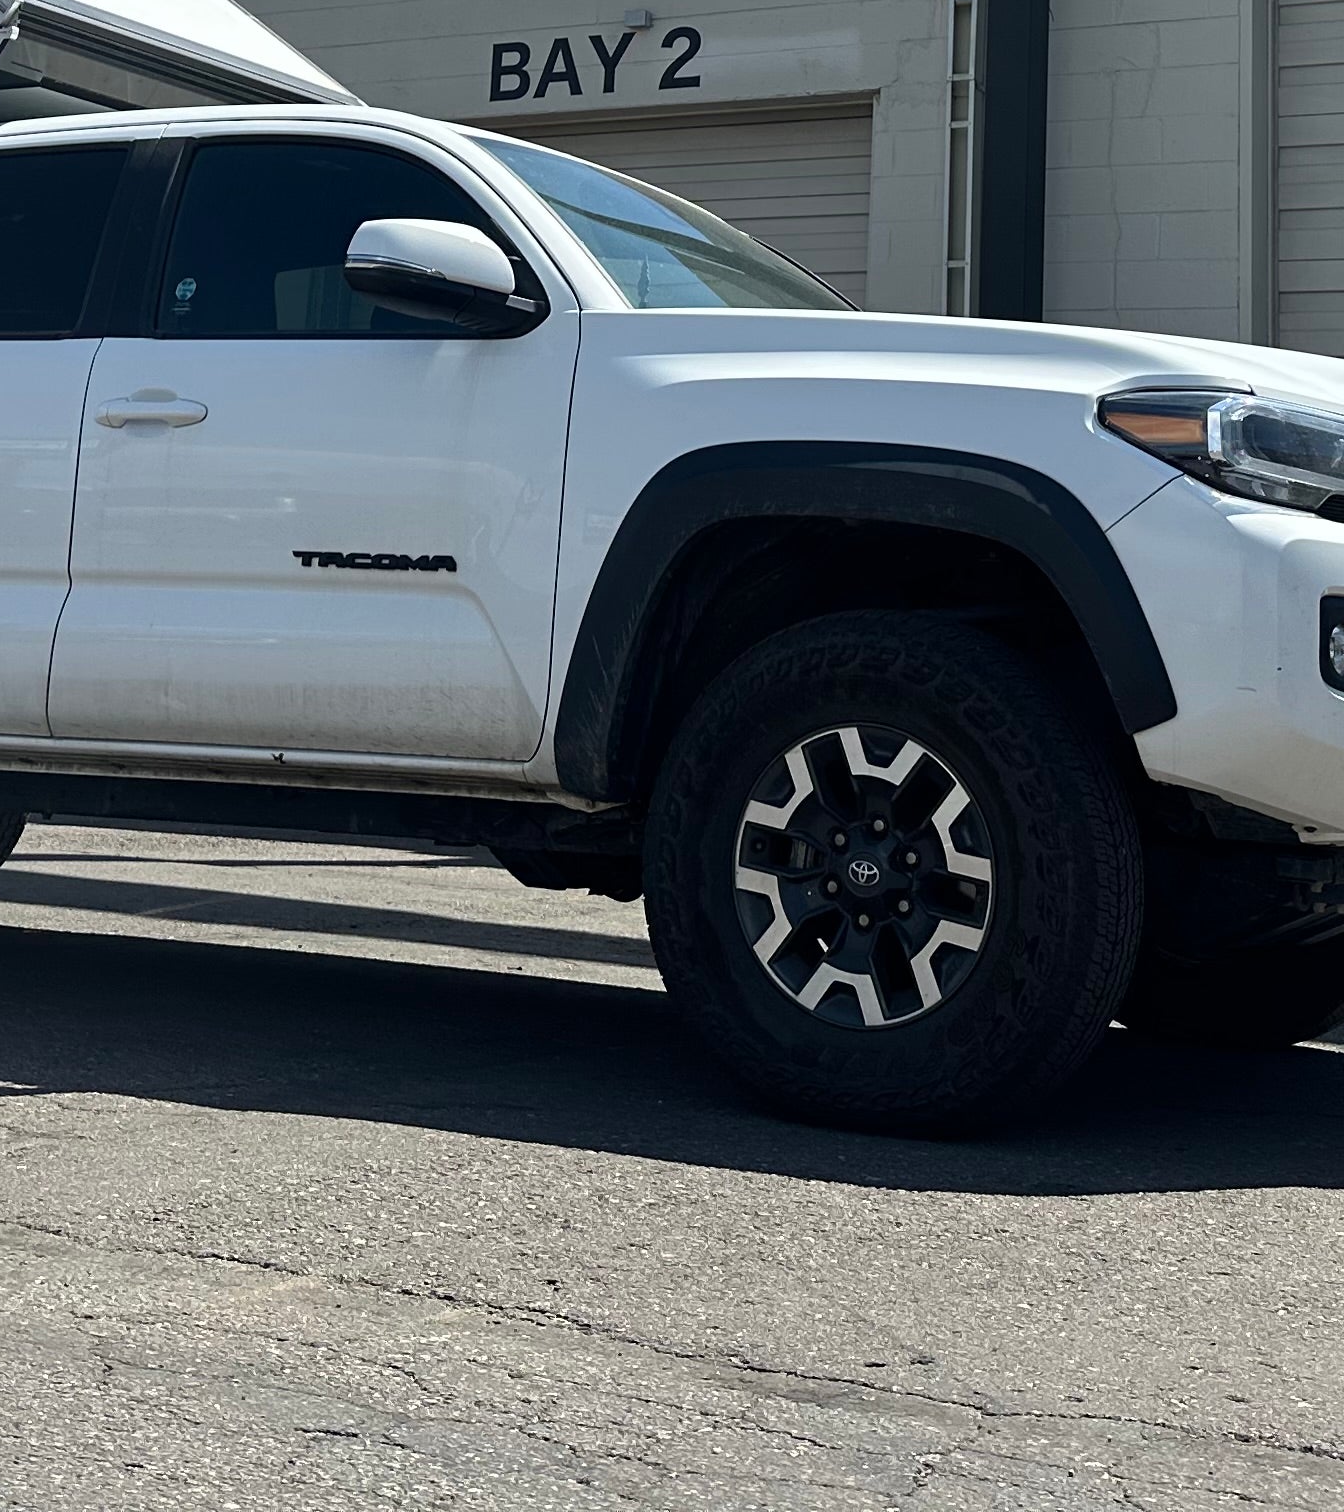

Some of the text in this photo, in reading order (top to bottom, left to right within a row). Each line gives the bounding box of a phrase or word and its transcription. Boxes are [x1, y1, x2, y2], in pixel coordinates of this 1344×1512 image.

[488, 25, 703, 103] BAY 2
[291, 550, 458, 573] TACOMA
